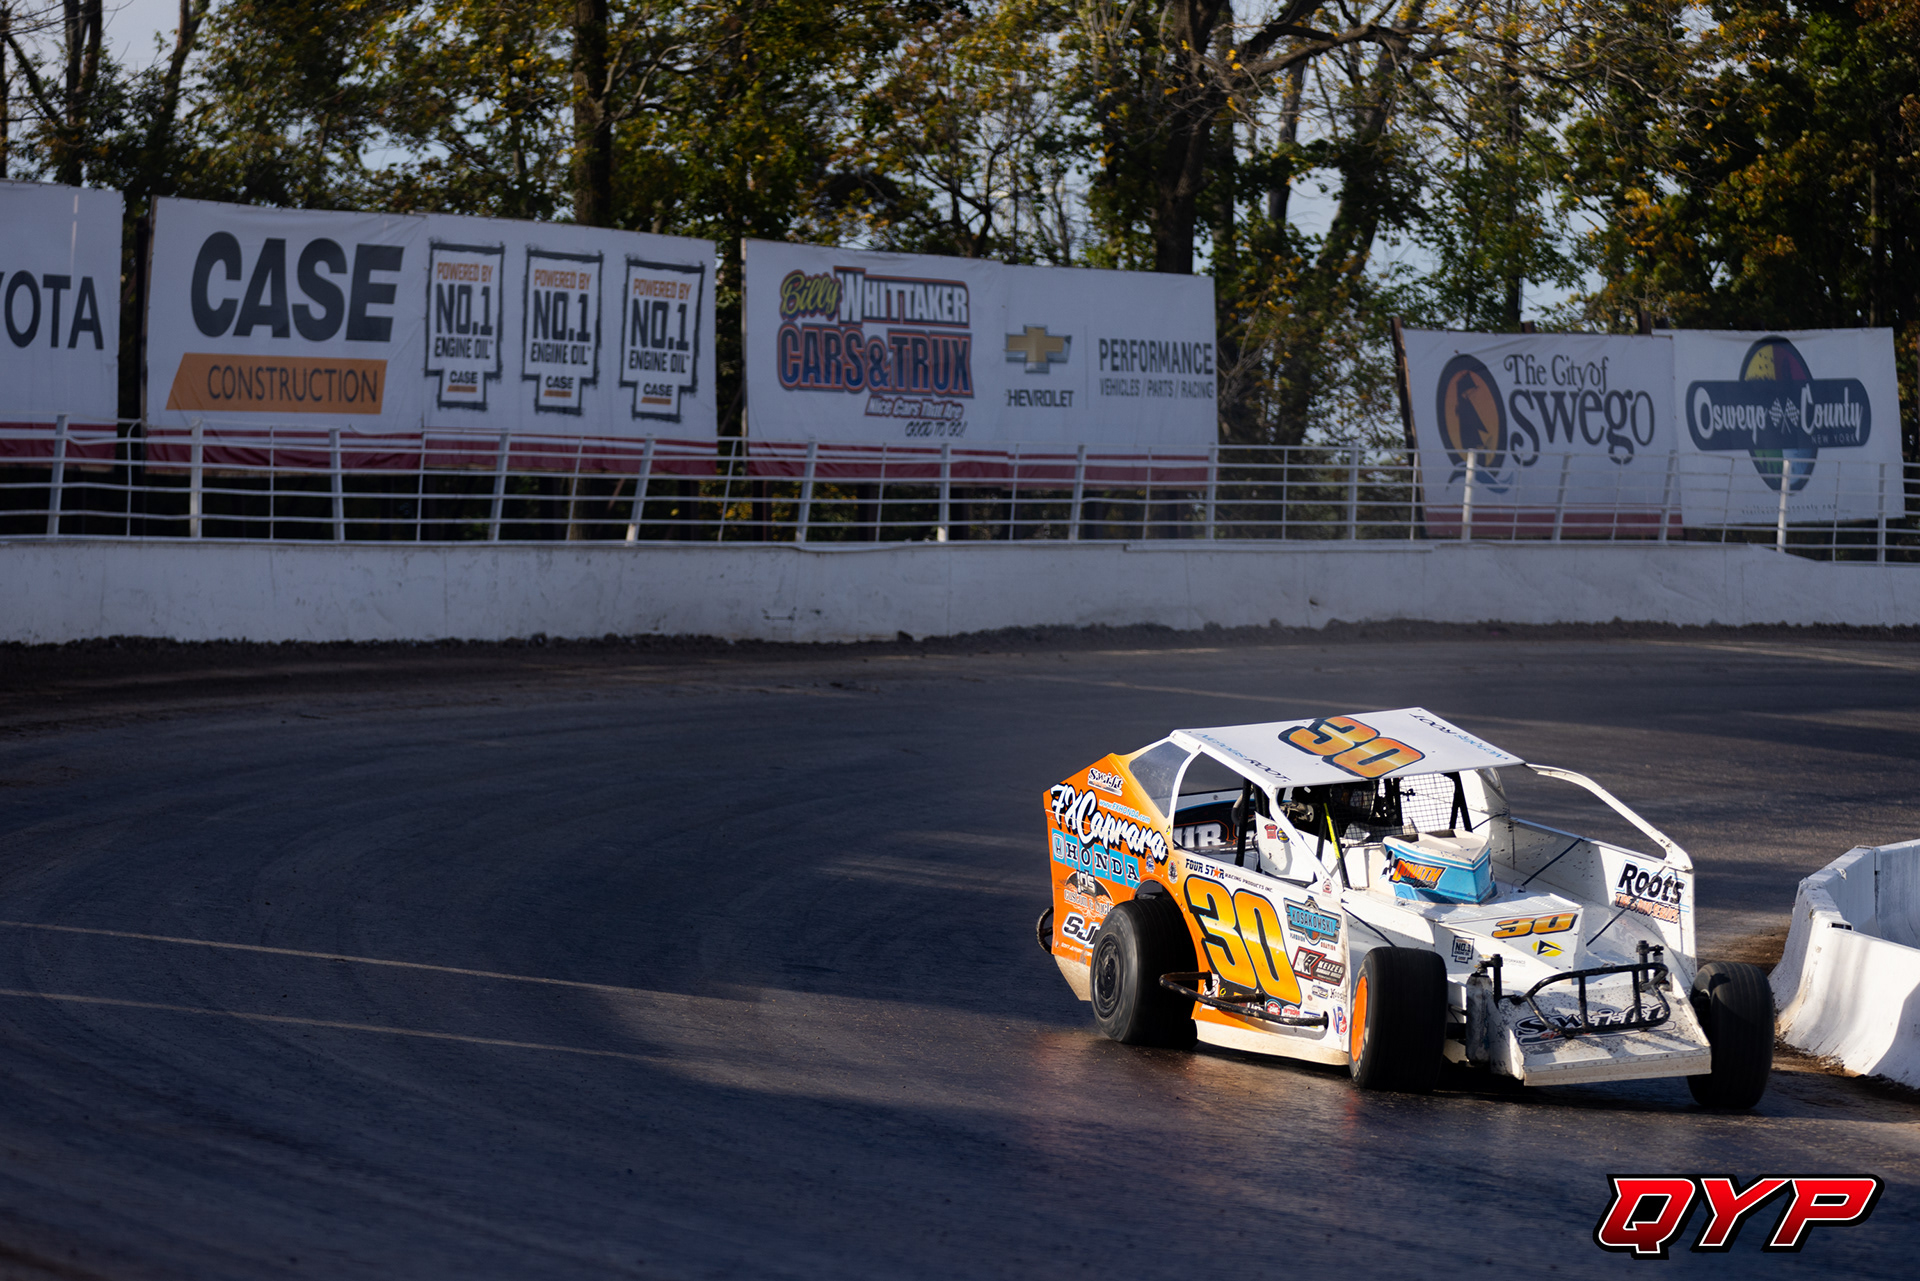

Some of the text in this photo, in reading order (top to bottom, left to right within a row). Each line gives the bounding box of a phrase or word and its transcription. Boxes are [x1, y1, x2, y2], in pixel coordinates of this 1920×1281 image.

[191, 231, 405, 342] CASE
[437, 262, 494, 282] POWERED BY
[534, 269, 592, 290] POWERED BY
[633, 278, 692, 300] POWERED BY
[780, 270, 970, 325] Billy WHITTAKER
[0, 270, 104, 350] OTA
[436, 283, 493, 336] NO.1
[533, 289, 591, 342] NO.1
[631, 298, 689, 351] NO.1
[434, 337, 473, 359] ENGINE
[531, 342, 569, 364] ENGINE
[629, 350, 667, 372] ENGINE
[1099, 338, 1214, 375] PERFORMANCE
[207, 364, 378, 402] CONSTRUCTION
[450, 370, 478, 384] CASE
[546, 376, 574, 389] CASE
[1503, 353, 1548, 386] The
[643, 383, 673, 396] CASE
[1099, 378, 1140, 397] VEHICLES
[1147, 379, 1173, 398] PARTS
[1181, 380, 1214, 399] RACING
[1693, 382, 1864, 445] Oswego County
[1811, 433, 1856, 445] NEW YORK
[1278, 715, 1426, 779] 30
[1066, 842, 1140, 882] HONDA
[1185, 858, 1204, 874] FOUR
[1391, 859, 1444, 883] DONATH
[1618, 863, 1685, 904] Roots
[1184, 874, 1302, 1007] 30
[1491, 913, 1578, 939] 30
